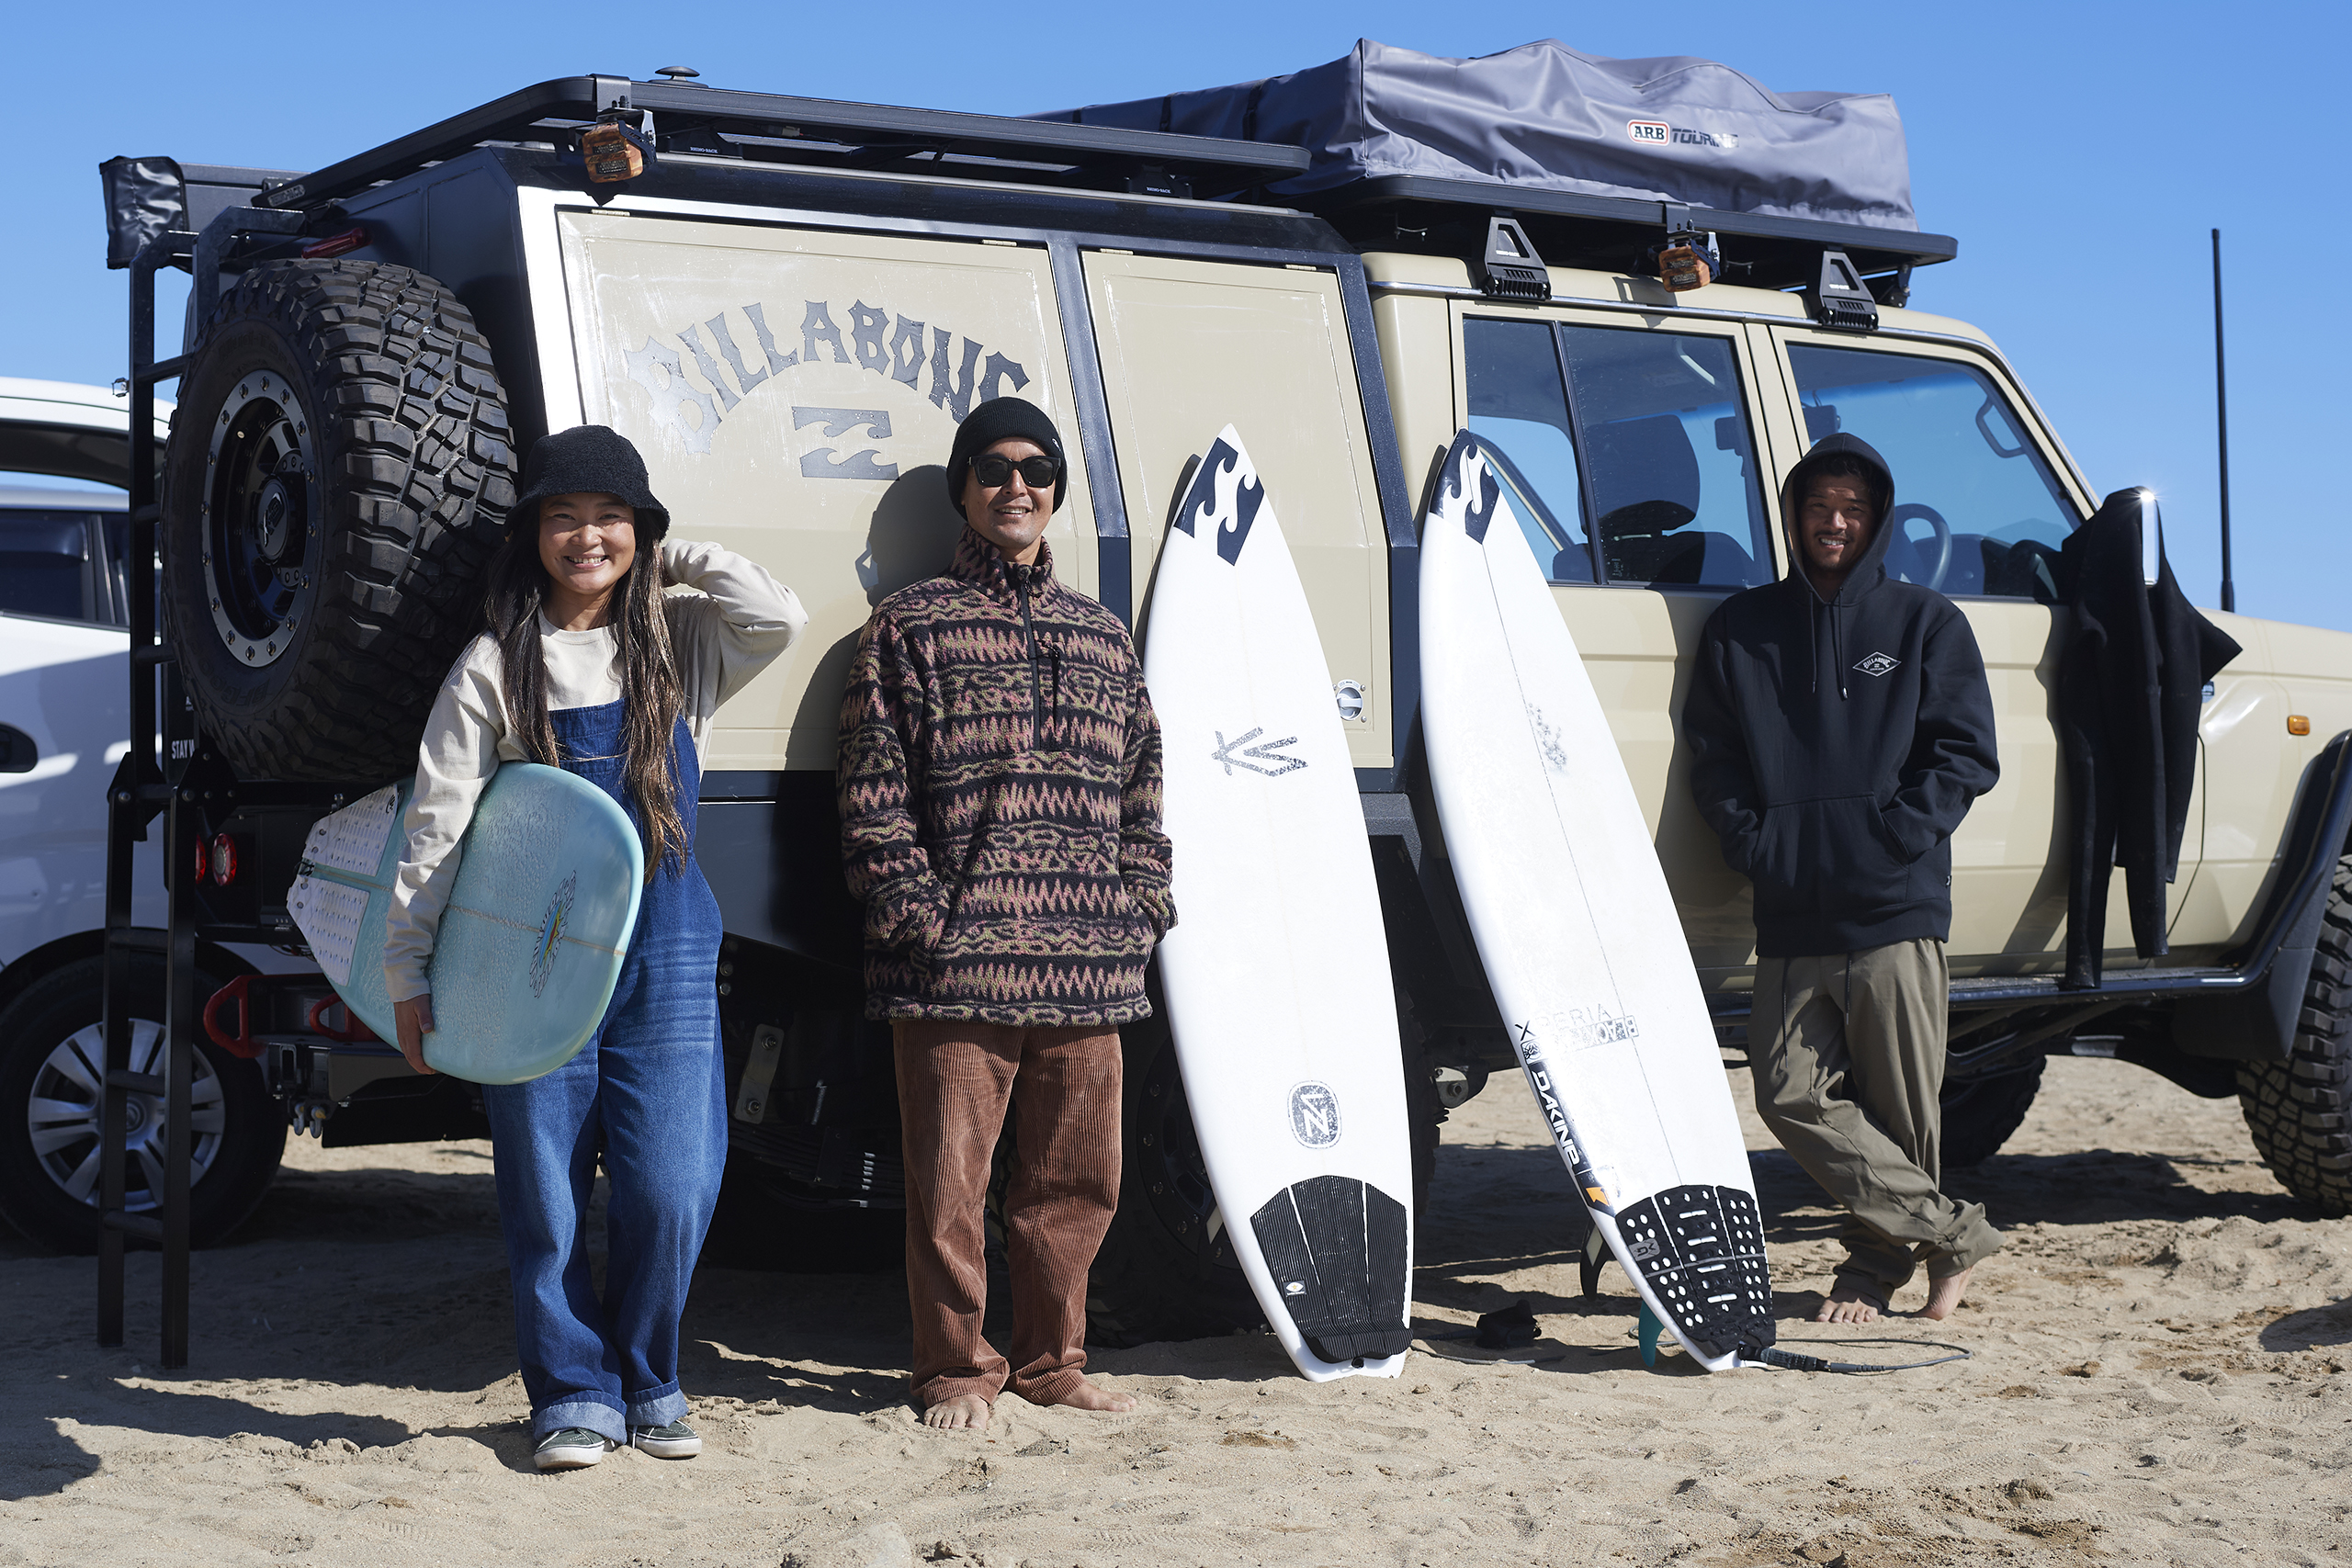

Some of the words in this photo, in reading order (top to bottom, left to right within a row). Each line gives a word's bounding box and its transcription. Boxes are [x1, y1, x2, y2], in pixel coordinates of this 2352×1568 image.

[1634, 126, 1665, 141] ARB
[1672, 128, 1739, 148] TOURING
[172, 739, 188, 760] STAY
[1532, 1070, 1580, 1167] DAKINE
